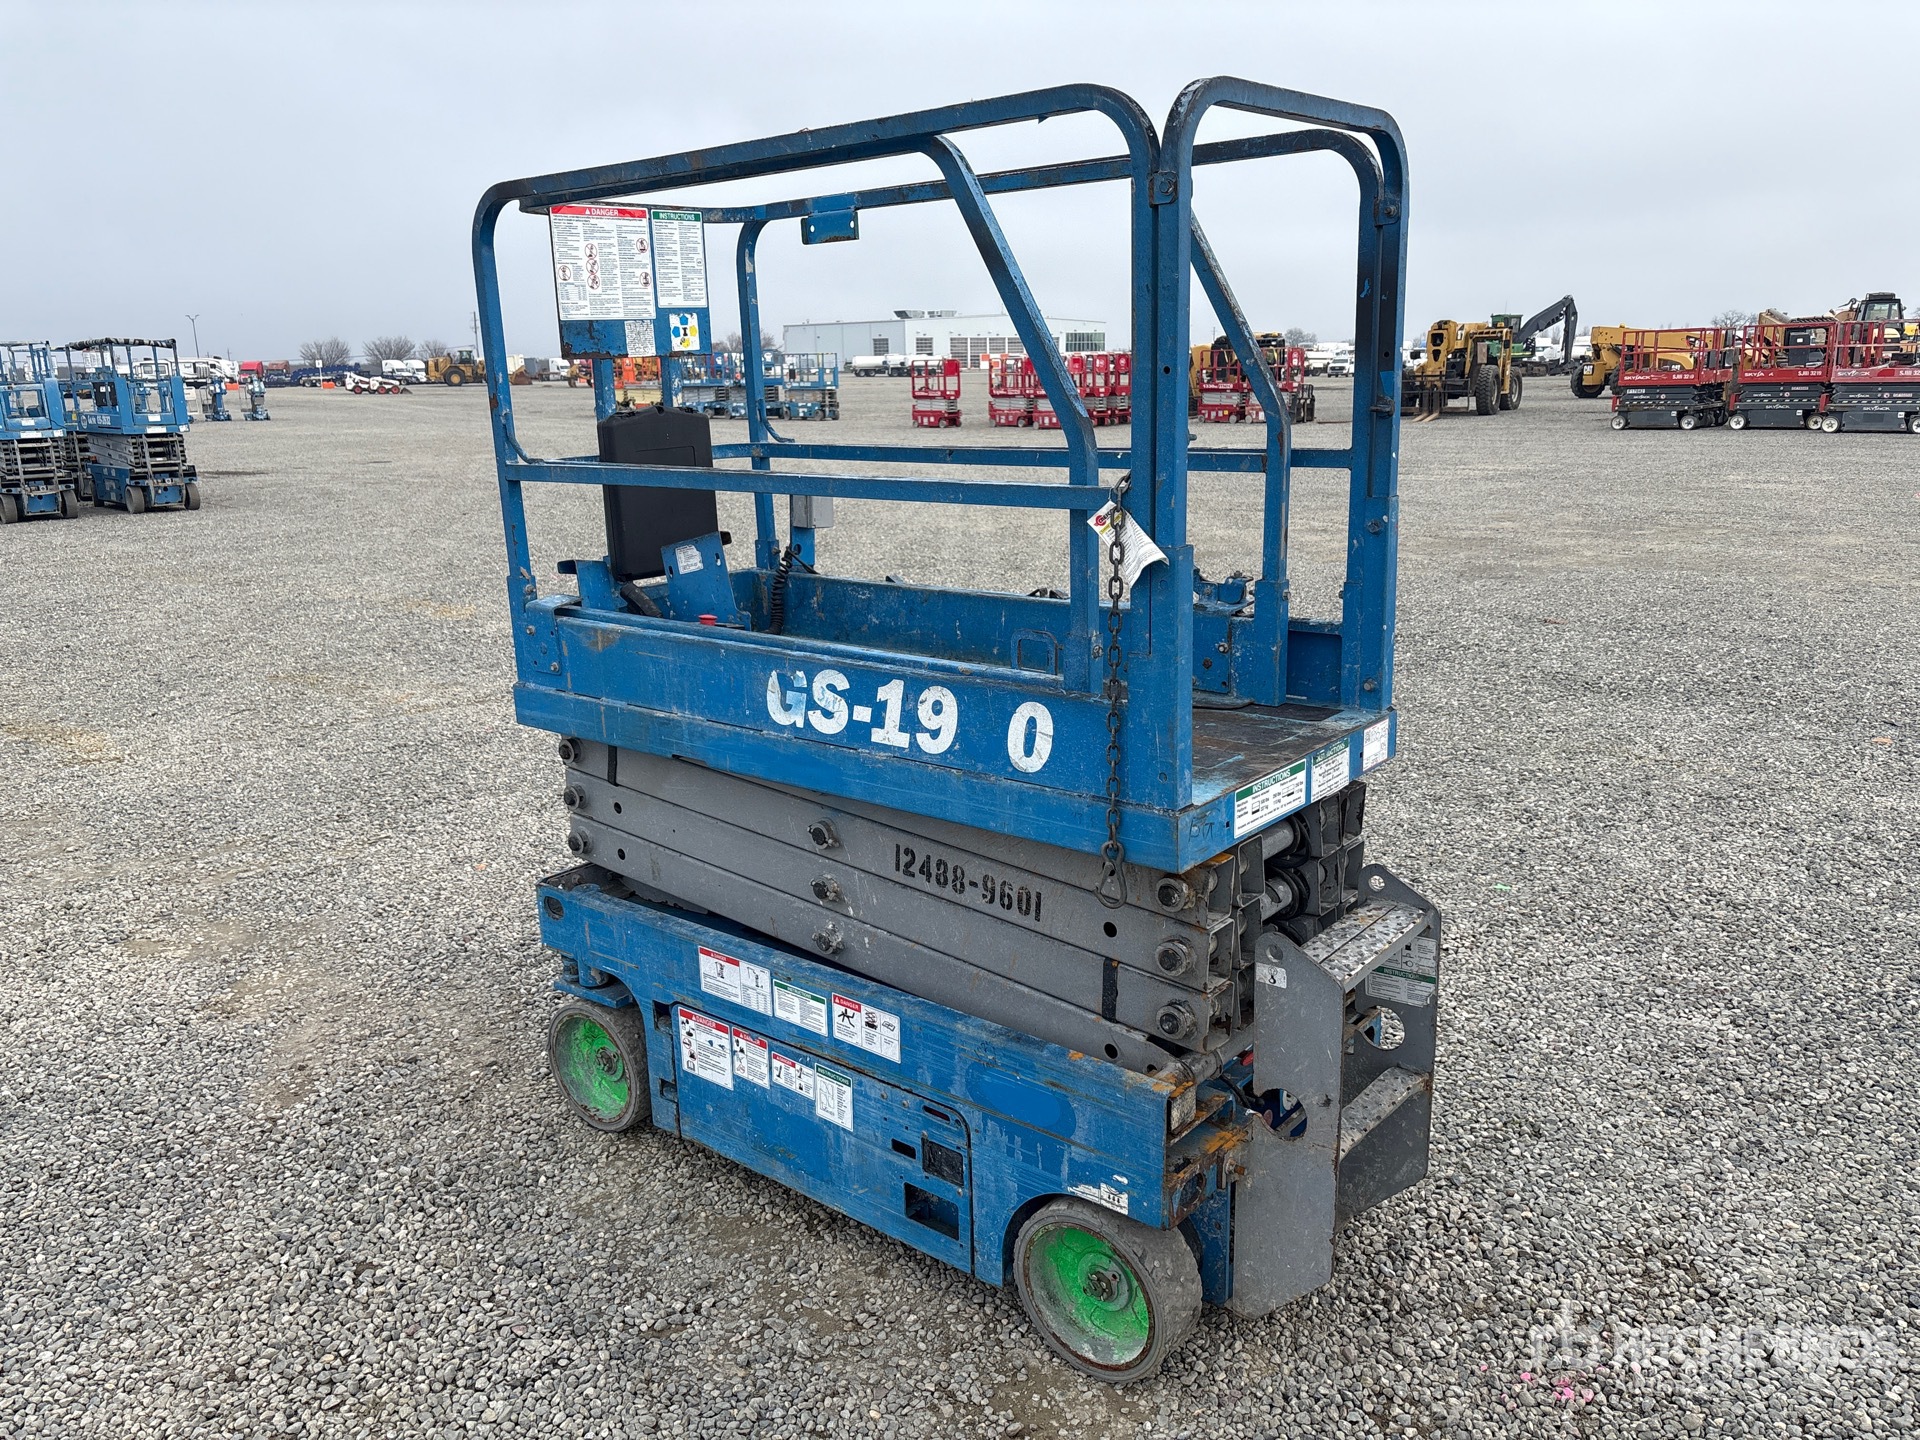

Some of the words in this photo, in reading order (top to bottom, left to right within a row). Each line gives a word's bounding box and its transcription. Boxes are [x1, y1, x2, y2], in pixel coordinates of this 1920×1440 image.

[591, 208, 619, 216] DANGER
[659, 212, 695, 221] INSTRUCTIONS
[1252, 769, 1291, 793] INSTRUCTIONS
[895, 843, 1042, 922] 12488-9601
[840, 999, 859, 1010] DANGER
[695, 1015, 717, 1028] DANGER
[817, 1066, 850, 1086] INSTRUCTIONS
